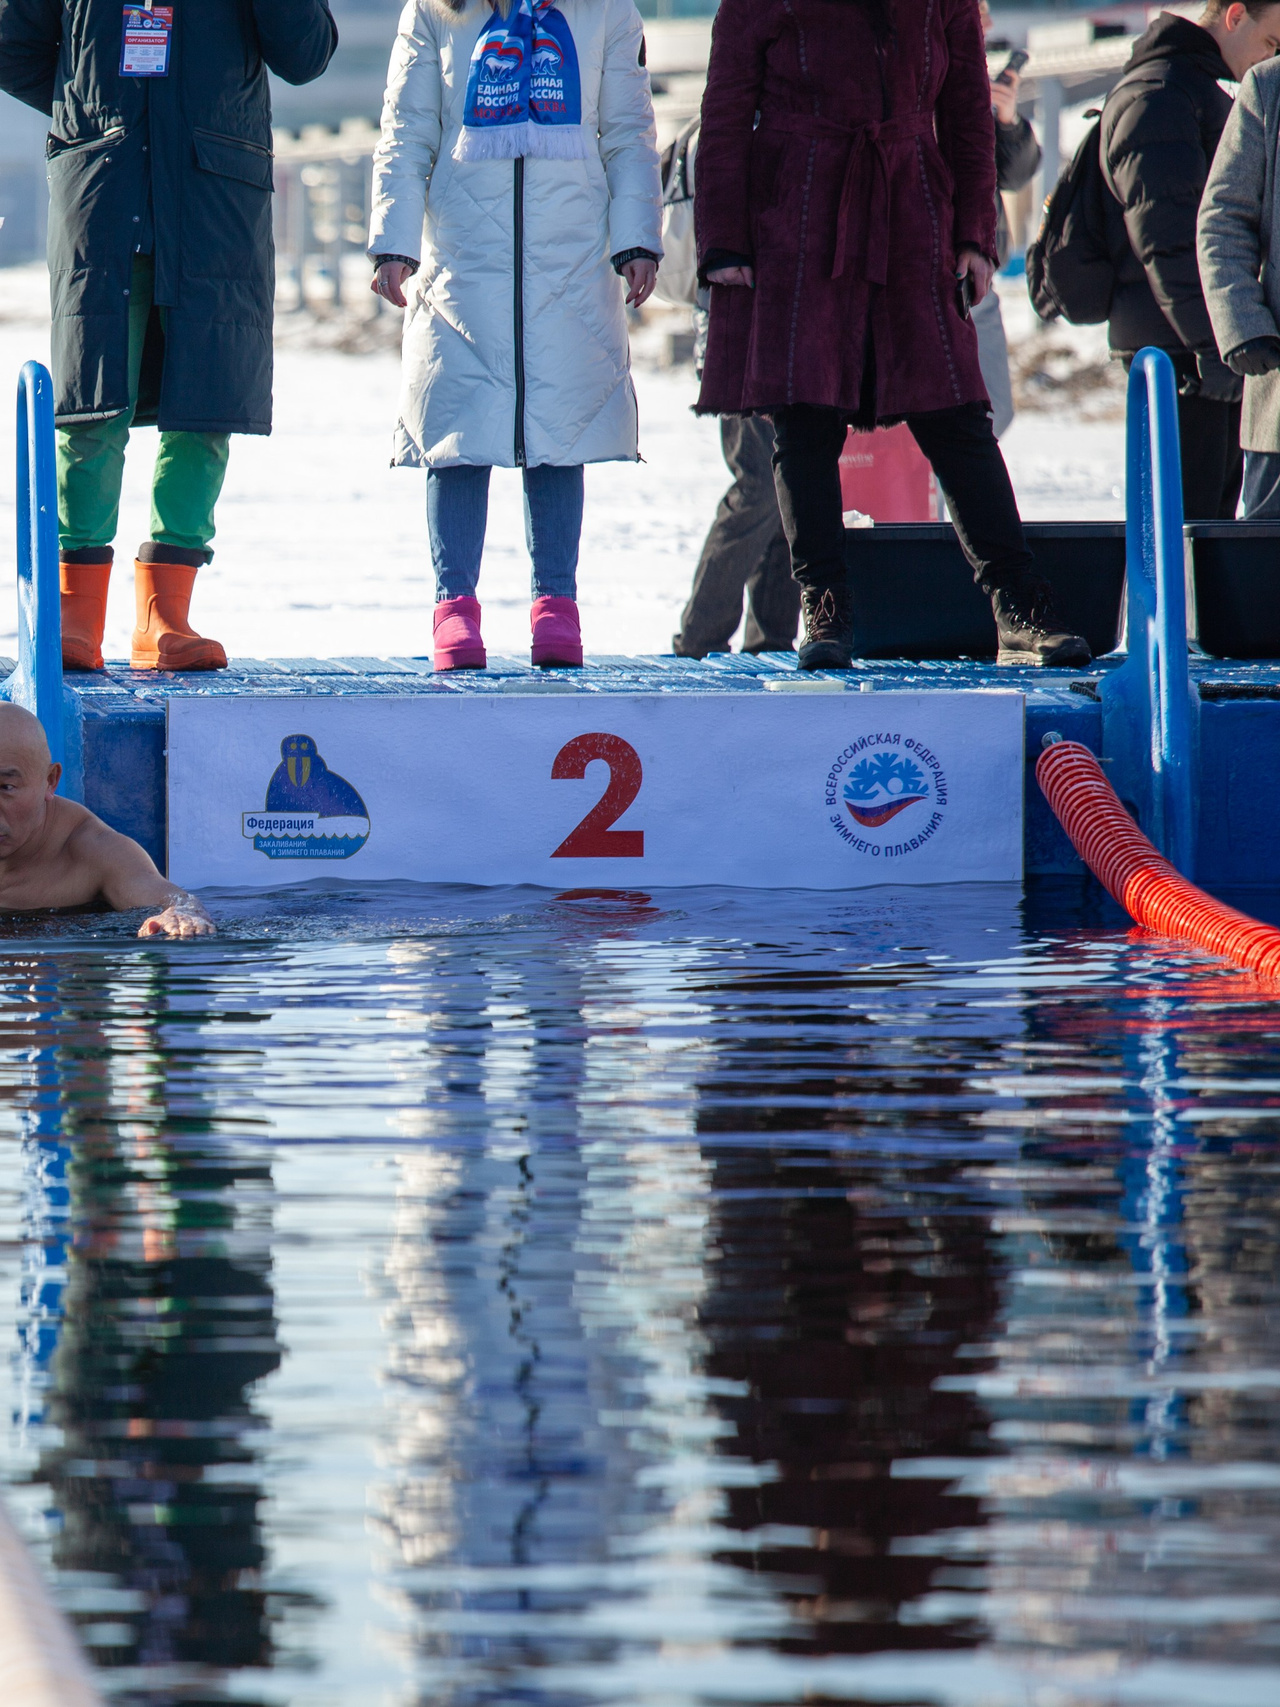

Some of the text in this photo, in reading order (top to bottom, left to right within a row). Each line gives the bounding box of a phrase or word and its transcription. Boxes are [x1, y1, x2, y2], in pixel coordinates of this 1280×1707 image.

[477, 82, 520, 95] ЕДИНАЯ
[530, 77, 563, 88] ИНАЯ
[477, 92, 519, 107] РОССИЯ
[473, 103, 522, 119] МОСКВА
[825, 733, 947, 806] ВСЕРОССИЙСКАЯ ФЕДЕРАЦИЯ
[549, 732, 644, 858] 2
[247, 817, 314, 831] Федерация
[830, 812, 944, 857] ЗИМНЕГО ПЛАВАНИЯ
[259, 840, 307, 848] ЗАКАЛИВАНИЯ
